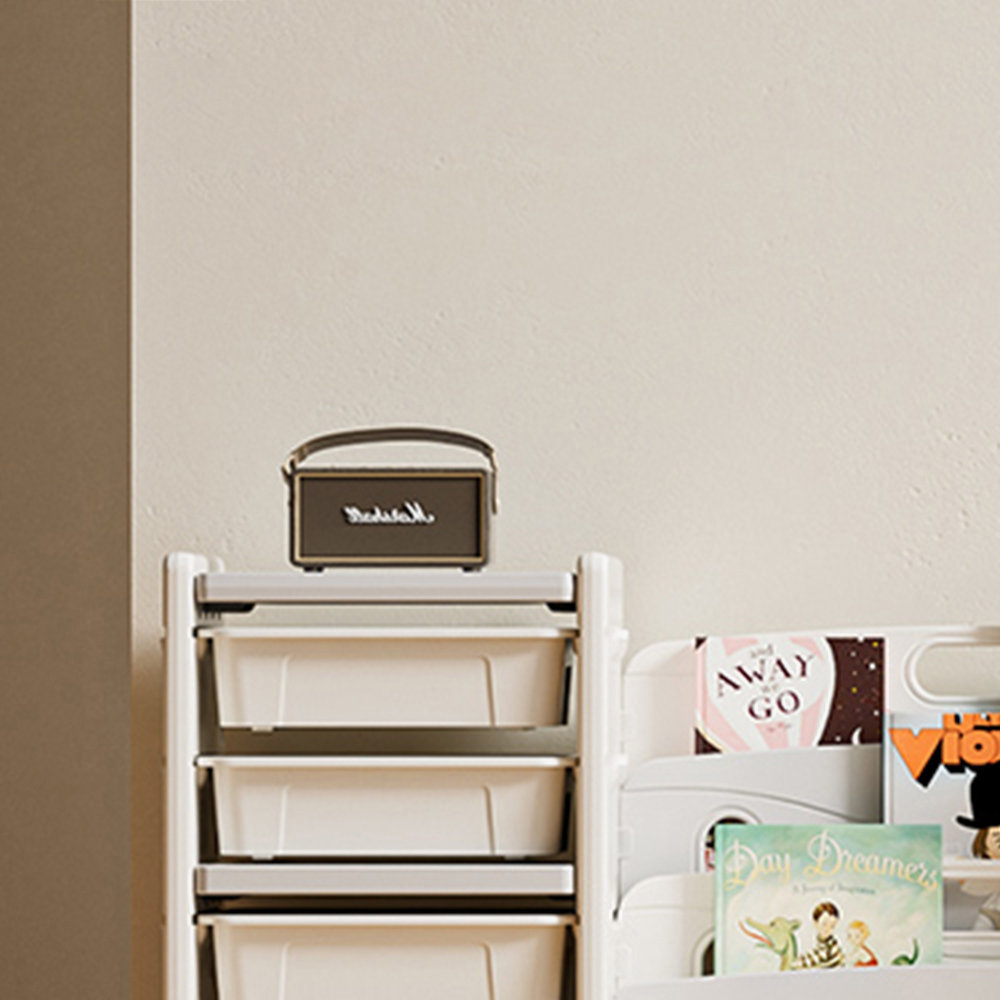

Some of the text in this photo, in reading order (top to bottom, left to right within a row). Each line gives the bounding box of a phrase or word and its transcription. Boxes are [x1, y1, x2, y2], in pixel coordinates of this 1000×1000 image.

[717, 653, 815, 698] AWAY
[747, 689, 801, 720] GO
[723, 828, 940, 893] Day Dreamers
